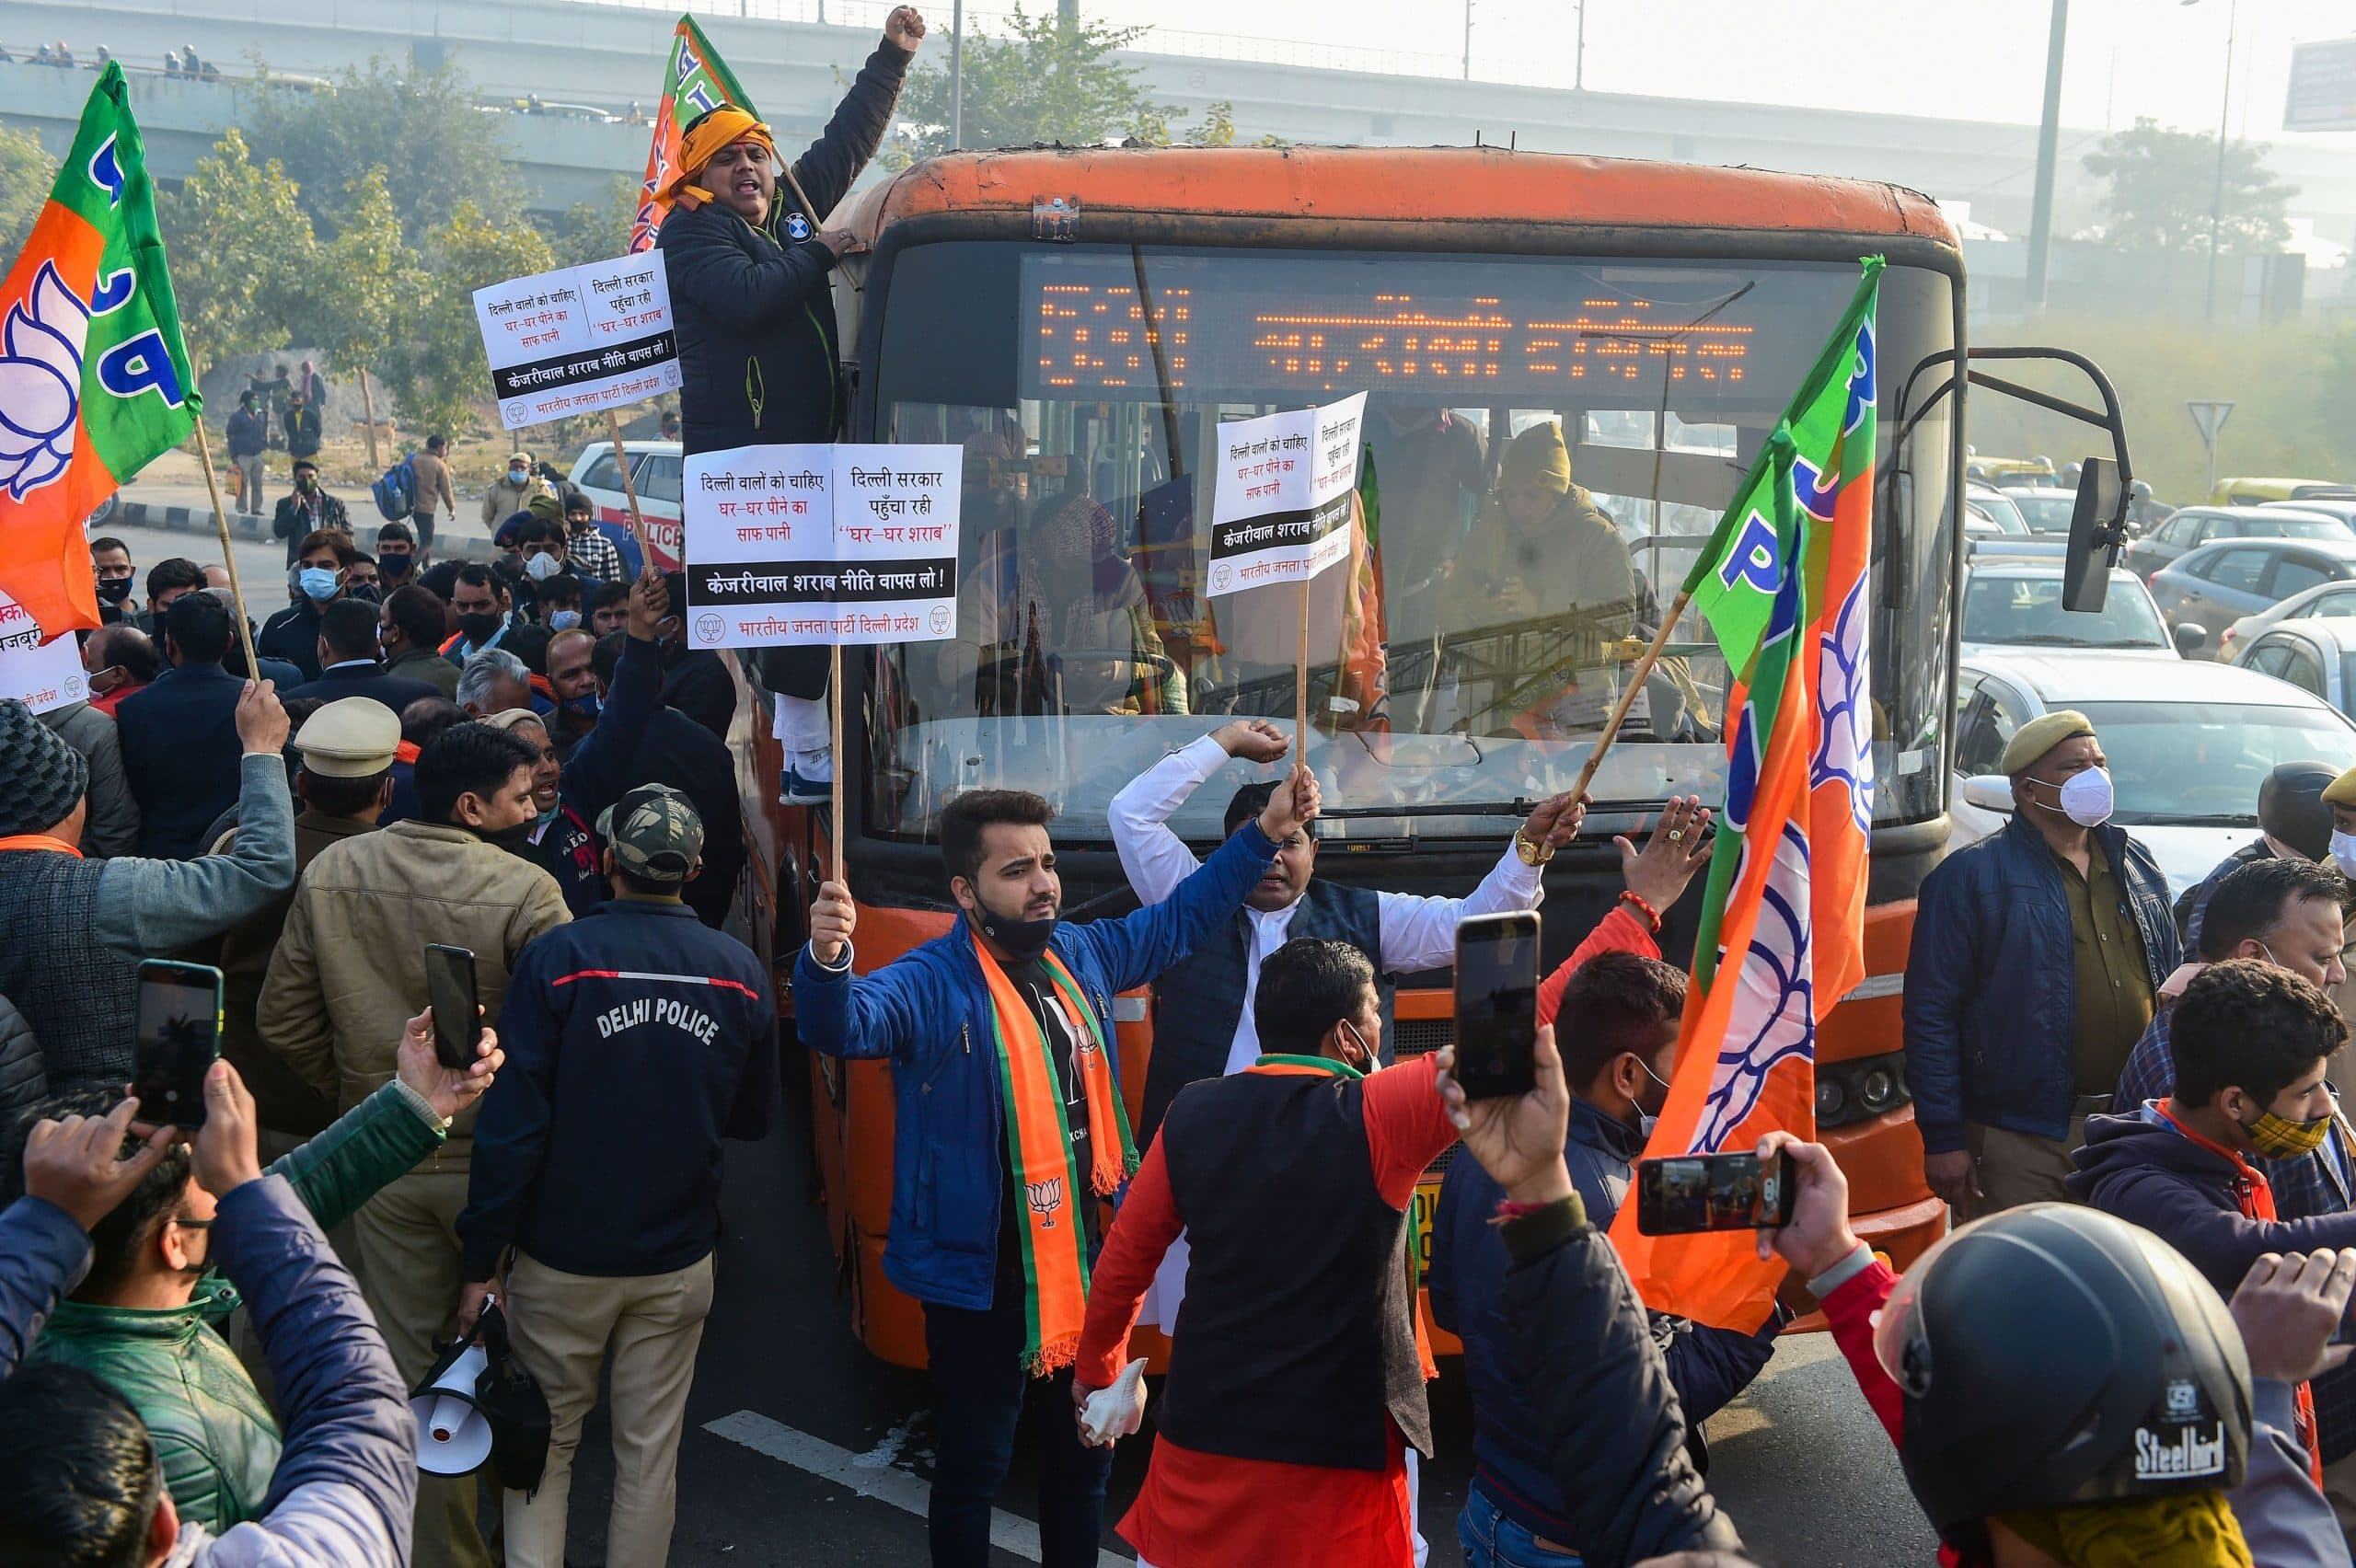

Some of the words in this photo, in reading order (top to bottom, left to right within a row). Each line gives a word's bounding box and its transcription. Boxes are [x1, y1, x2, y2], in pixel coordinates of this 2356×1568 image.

[593, 278, 622, 294] दिल्ली
[626, 271, 654, 288] सरकार
[488, 303, 513, 316] दिल्ली
[514, 294, 536, 311] वालों
[537, 292, 548, 307] को
[550, 289, 576, 305] चाहिए
[610, 294, 637, 313] पहुँचा
[639, 292, 651, 305] रही
[539, 310, 555, 325] पीने
[557, 310, 567, 322] का
[521, 335, 540, 348] साफ
[541, 330, 560, 344] पानी
[507, 363, 564, 389] केजरीवाल
[569, 359, 600, 376] शराब
[603, 352, 627, 369] नीति
[629, 346, 652, 363] वापस
[537, 398, 571, 414] भारतीय
[573, 392, 599, 406] जनता
[602, 386, 620, 399] पार्टी
[622, 380, 642, 394] दिल्ली
[644, 375, 660, 388] प्रदेश
[1322, 421, 1338, 443] दिल्ली
[1340, 417, 1356, 435] सरकार
[1230, 444, 1250, 461] दिल्ली
[1252, 438, 1268, 455] वालों
[1270, 440, 1280, 454] को
[1283, 433, 1307, 451] चाहिए
[851, 467, 891, 488] दिल्ली
[896, 472, 942, 488] सरकार
[1266, 459, 1282, 474] पीने
[1283, 460, 1295, 471] का
[700, 474, 734, 491] दिल्ली
[739, 473, 766, 490] वालों
[770, 471, 784, 490] को
[790, 470, 825, 491] चाहिए
[1245, 487, 1261, 501] साफ
[1264, 482, 1280, 497] पानी
[767, 496, 788, 515] पीने
[792, 501, 808, 515] का
[869, 494, 906, 520] पहुँचा
[912, 495, 931, 515] रही
[622, 519, 680, 547] PLICE
[736, 526, 762, 542] साफ
[767, 523, 791, 541] पानी
[1224, 525, 1273, 548] केजरीवाल
[1277, 521, 1311, 538] शराब
[1241, 560, 1270, 580] भारतीय
[1273, 559, 1299, 574] जनता
[706, 572, 788, 594] केजरीवाल
[792, 575, 836, 593] शराब
[841, 571, 874, 592] नीति
[879, 573, 915, 591] वापस
[739, 617, 788, 637] भारतीय
[791, 619, 827, 635] जनता
[830, 611, 855, 634] पार्टी
[860, 614, 891, 633] दिल्ली
[895, 613, 919, 632] प्रदेश
[596, 998, 651, 1038] DELHI
[655, 998, 720, 1046] POLICE
[2135, 1421, 2224, 1475] Steelbird
